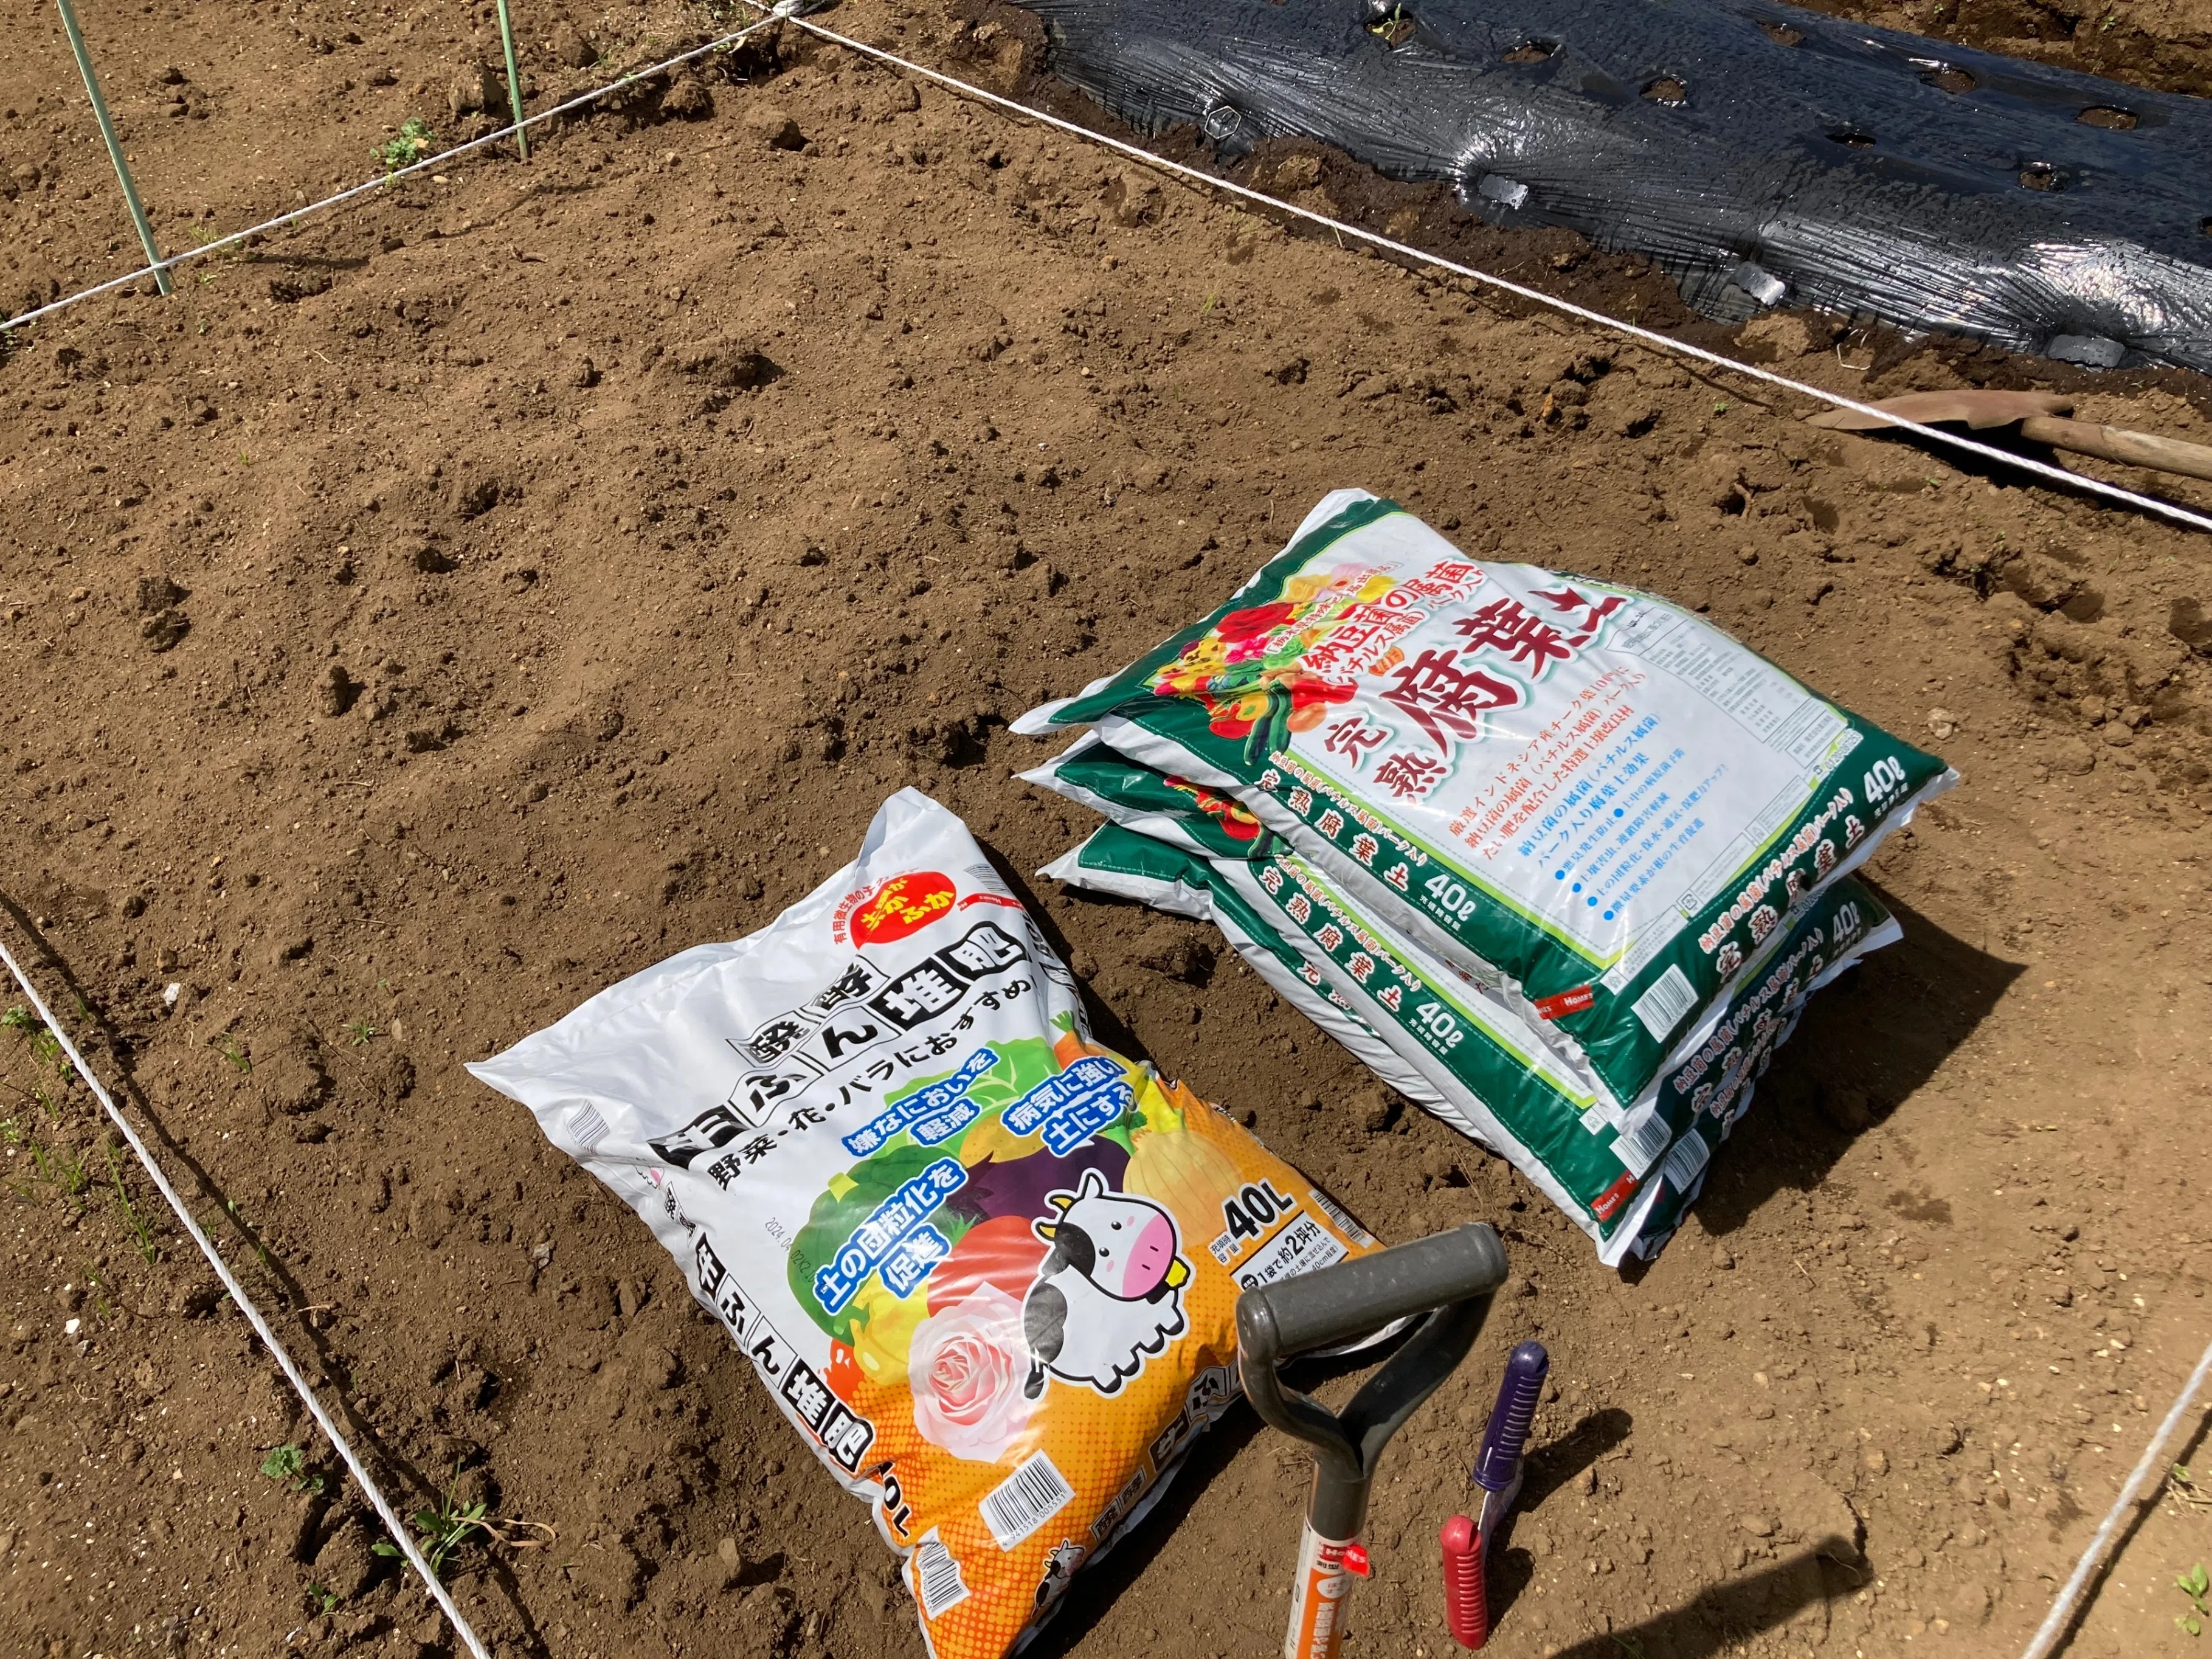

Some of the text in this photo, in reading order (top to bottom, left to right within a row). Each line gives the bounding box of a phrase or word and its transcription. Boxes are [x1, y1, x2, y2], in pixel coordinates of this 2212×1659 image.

[1301, 560, 1478, 672] 納豆菌の属菌
[1380, 587, 1628, 758] 腐葉土
[1323, 716, 1448, 805] 完熟
[1482, 705, 1634, 860] たい肥を配合した特選土壌改良材
[1537, 753, 1649, 868] バーク入り腐葉土効果
[1257, 770, 1408, 890] 完熟腐葉土
[1260, 866, 1402, 1011] 完熟腐葉土
[654, 924, 1025, 1162] 牛ふん堆肥
[707, 979, 1030, 1190] 野菜・花・バラにおすすめ
[1008, 1058, 1127, 1131] 病気に強い
[848, 1051, 997, 1154] 嫌なにおいを
[916, 1102, 975, 1142] 軽減
[1047, 1082, 1136, 1153] 土にする
[818, 1163, 959, 1309] 土の団粒化を
[886, 1230, 949, 1292] 促進
[1224, 1182, 1293, 1239] 40L
[1257, 1221, 1321, 1283] 1袋で約2坪分
[697, 1238, 872, 1469] 牛ふん堆肥
[1039, 1492, 1066, 1519] 005551
